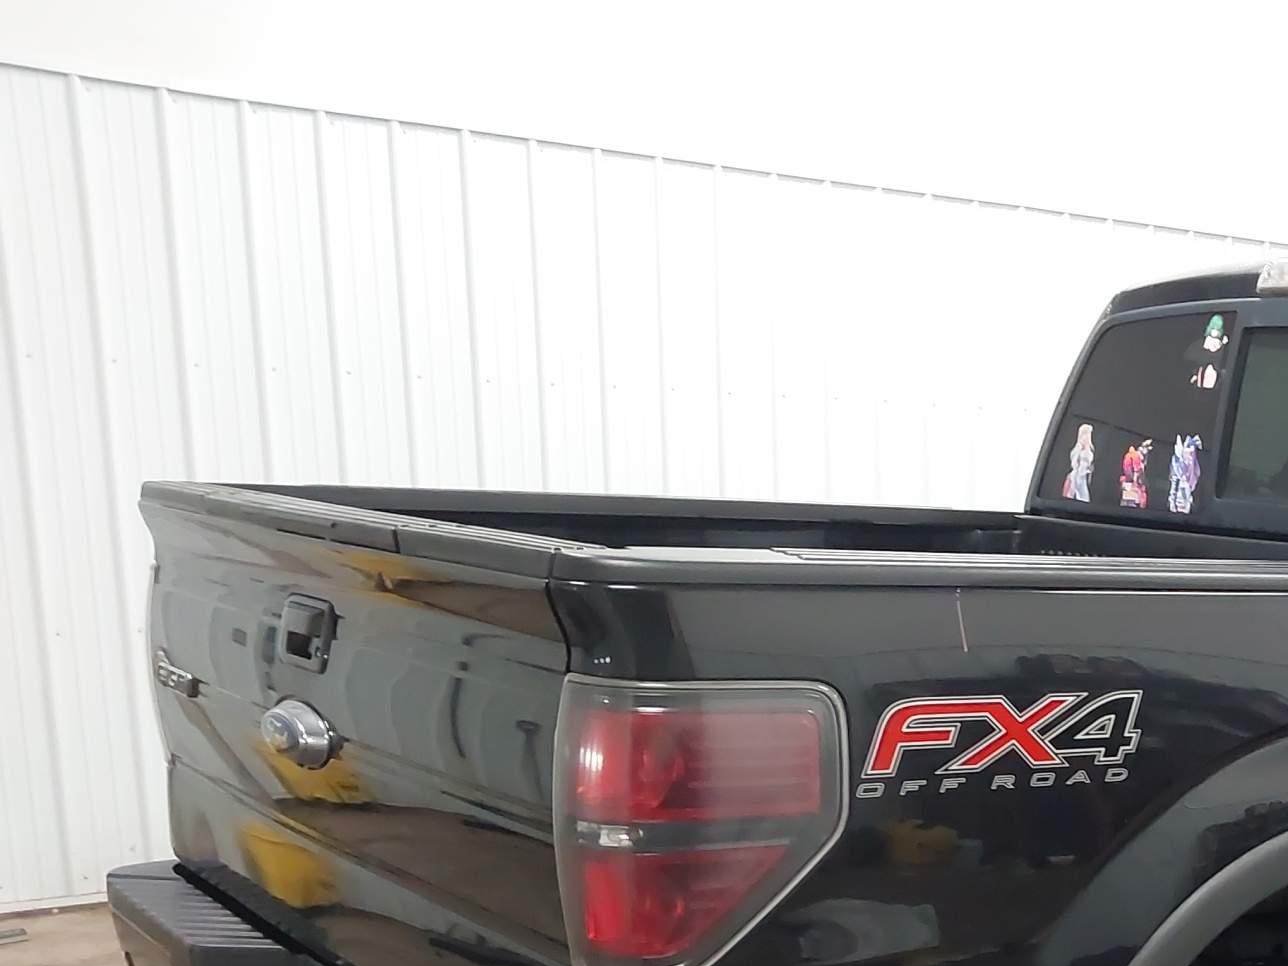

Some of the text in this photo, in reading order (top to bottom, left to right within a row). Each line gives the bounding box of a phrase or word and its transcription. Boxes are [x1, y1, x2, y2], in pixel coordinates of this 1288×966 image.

[861, 690, 1143, 778] FX4
[856, 767, 1129, 798] OFF ROAD
